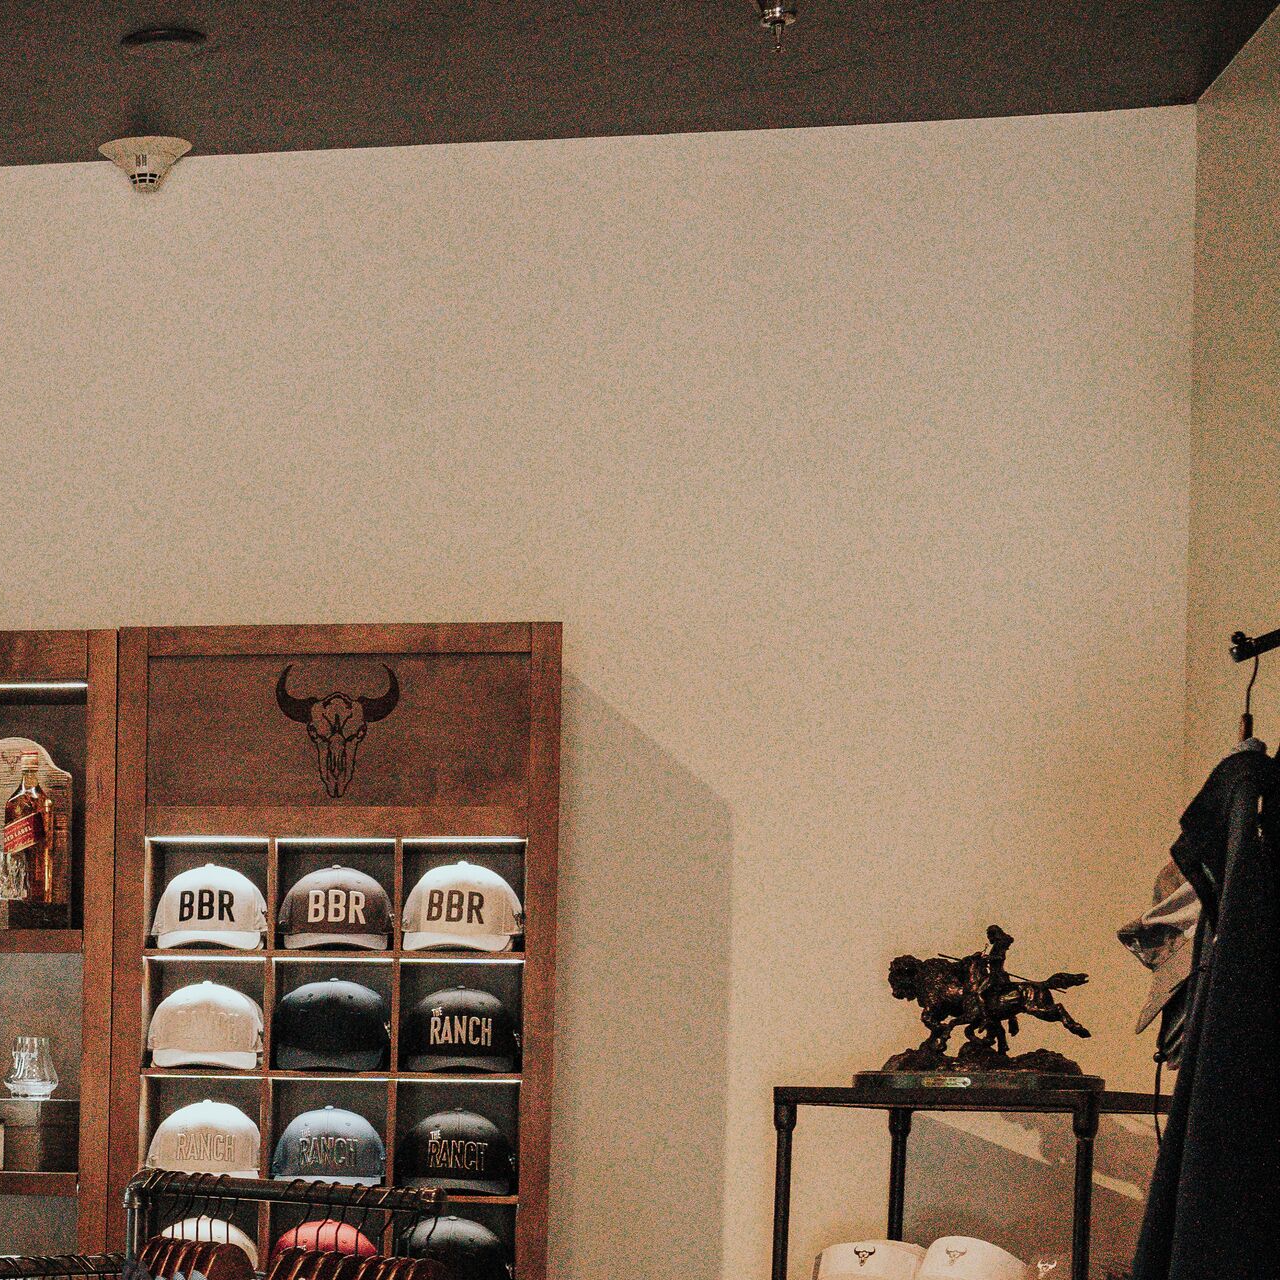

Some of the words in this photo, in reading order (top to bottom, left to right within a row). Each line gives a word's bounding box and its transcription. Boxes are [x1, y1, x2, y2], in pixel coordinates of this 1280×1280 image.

[14, 825, 32, 837] LABEL
[178, 889, 235, 922] BBR
[307, 889, 366, 924] BBR
[426, 889, 485, 924] BBR
[431, 1006, 443, 1017] THE
[430, 1015, 492, 1047] RANCH
[176, 1132, 237, 1162] RANCH
[429, 1129, 441, 1140] THE
[299, 1136, 359, 1166] RANCH
[428, 1139, 488, 1171] RANCH
